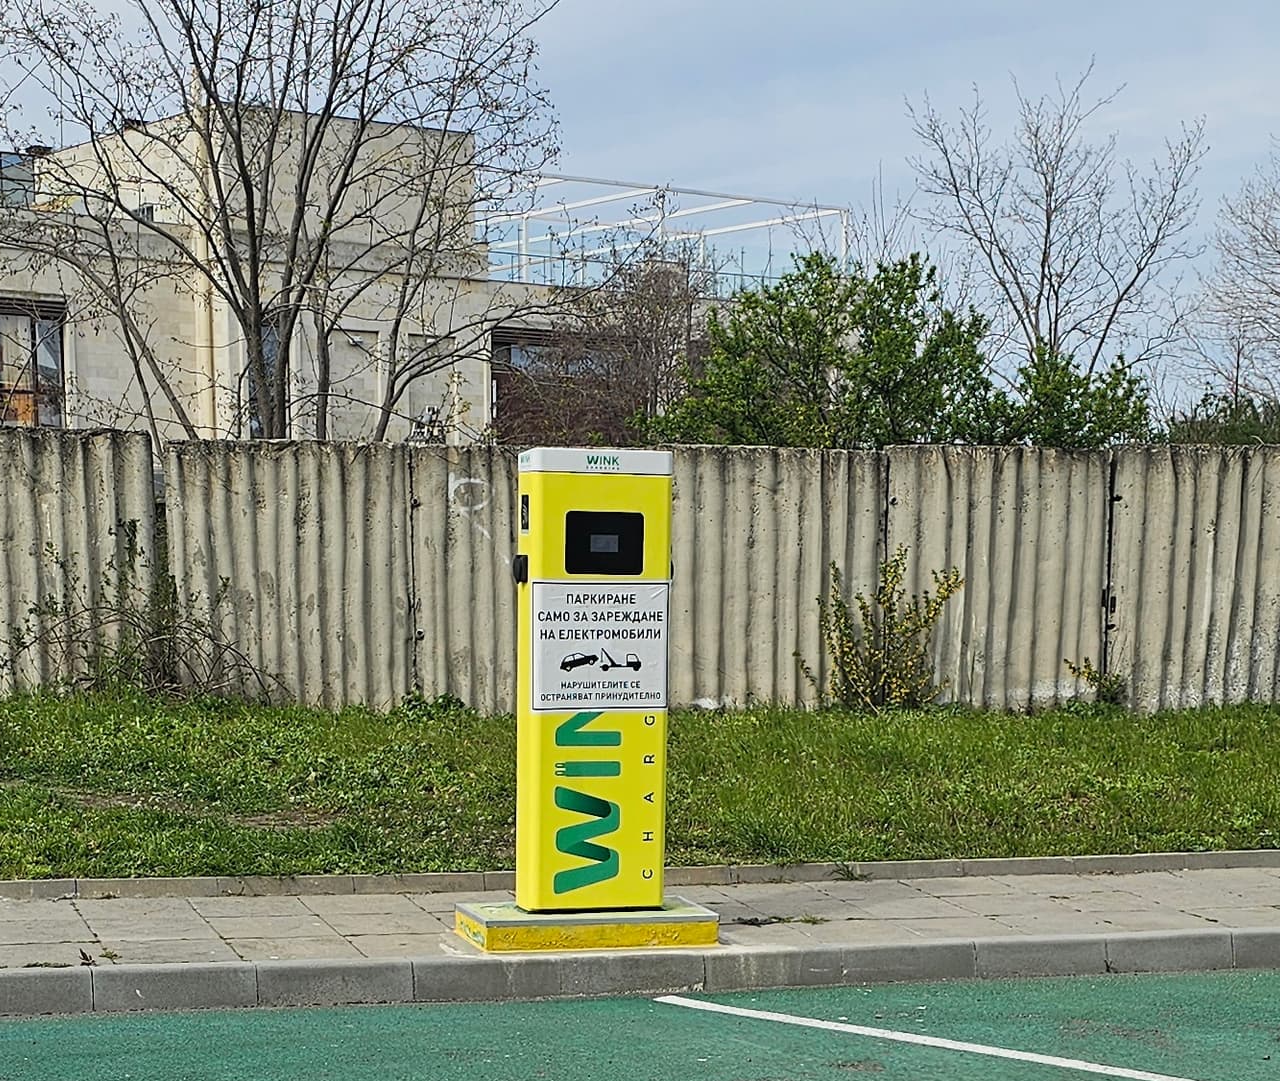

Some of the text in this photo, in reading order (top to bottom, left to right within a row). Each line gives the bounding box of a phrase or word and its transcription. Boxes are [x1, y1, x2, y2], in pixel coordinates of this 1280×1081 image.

[586, 455, 620, 466] WINK
[566, 594, 637, 604] ПАРКИРАНЕ
[538, 611, 663, 623] САМО ЗА ЗАРЕЖДАНЕ
[540, 629, 661, 640] НА ЕЛЕКТРОМОБИЛИ
[561, 681, 628, 689] НАРУШИТЕЛИТЕ
[540, 692, 661, 701] ОСТРАНЯВАТ ПРИНУДИТЕЛНО
